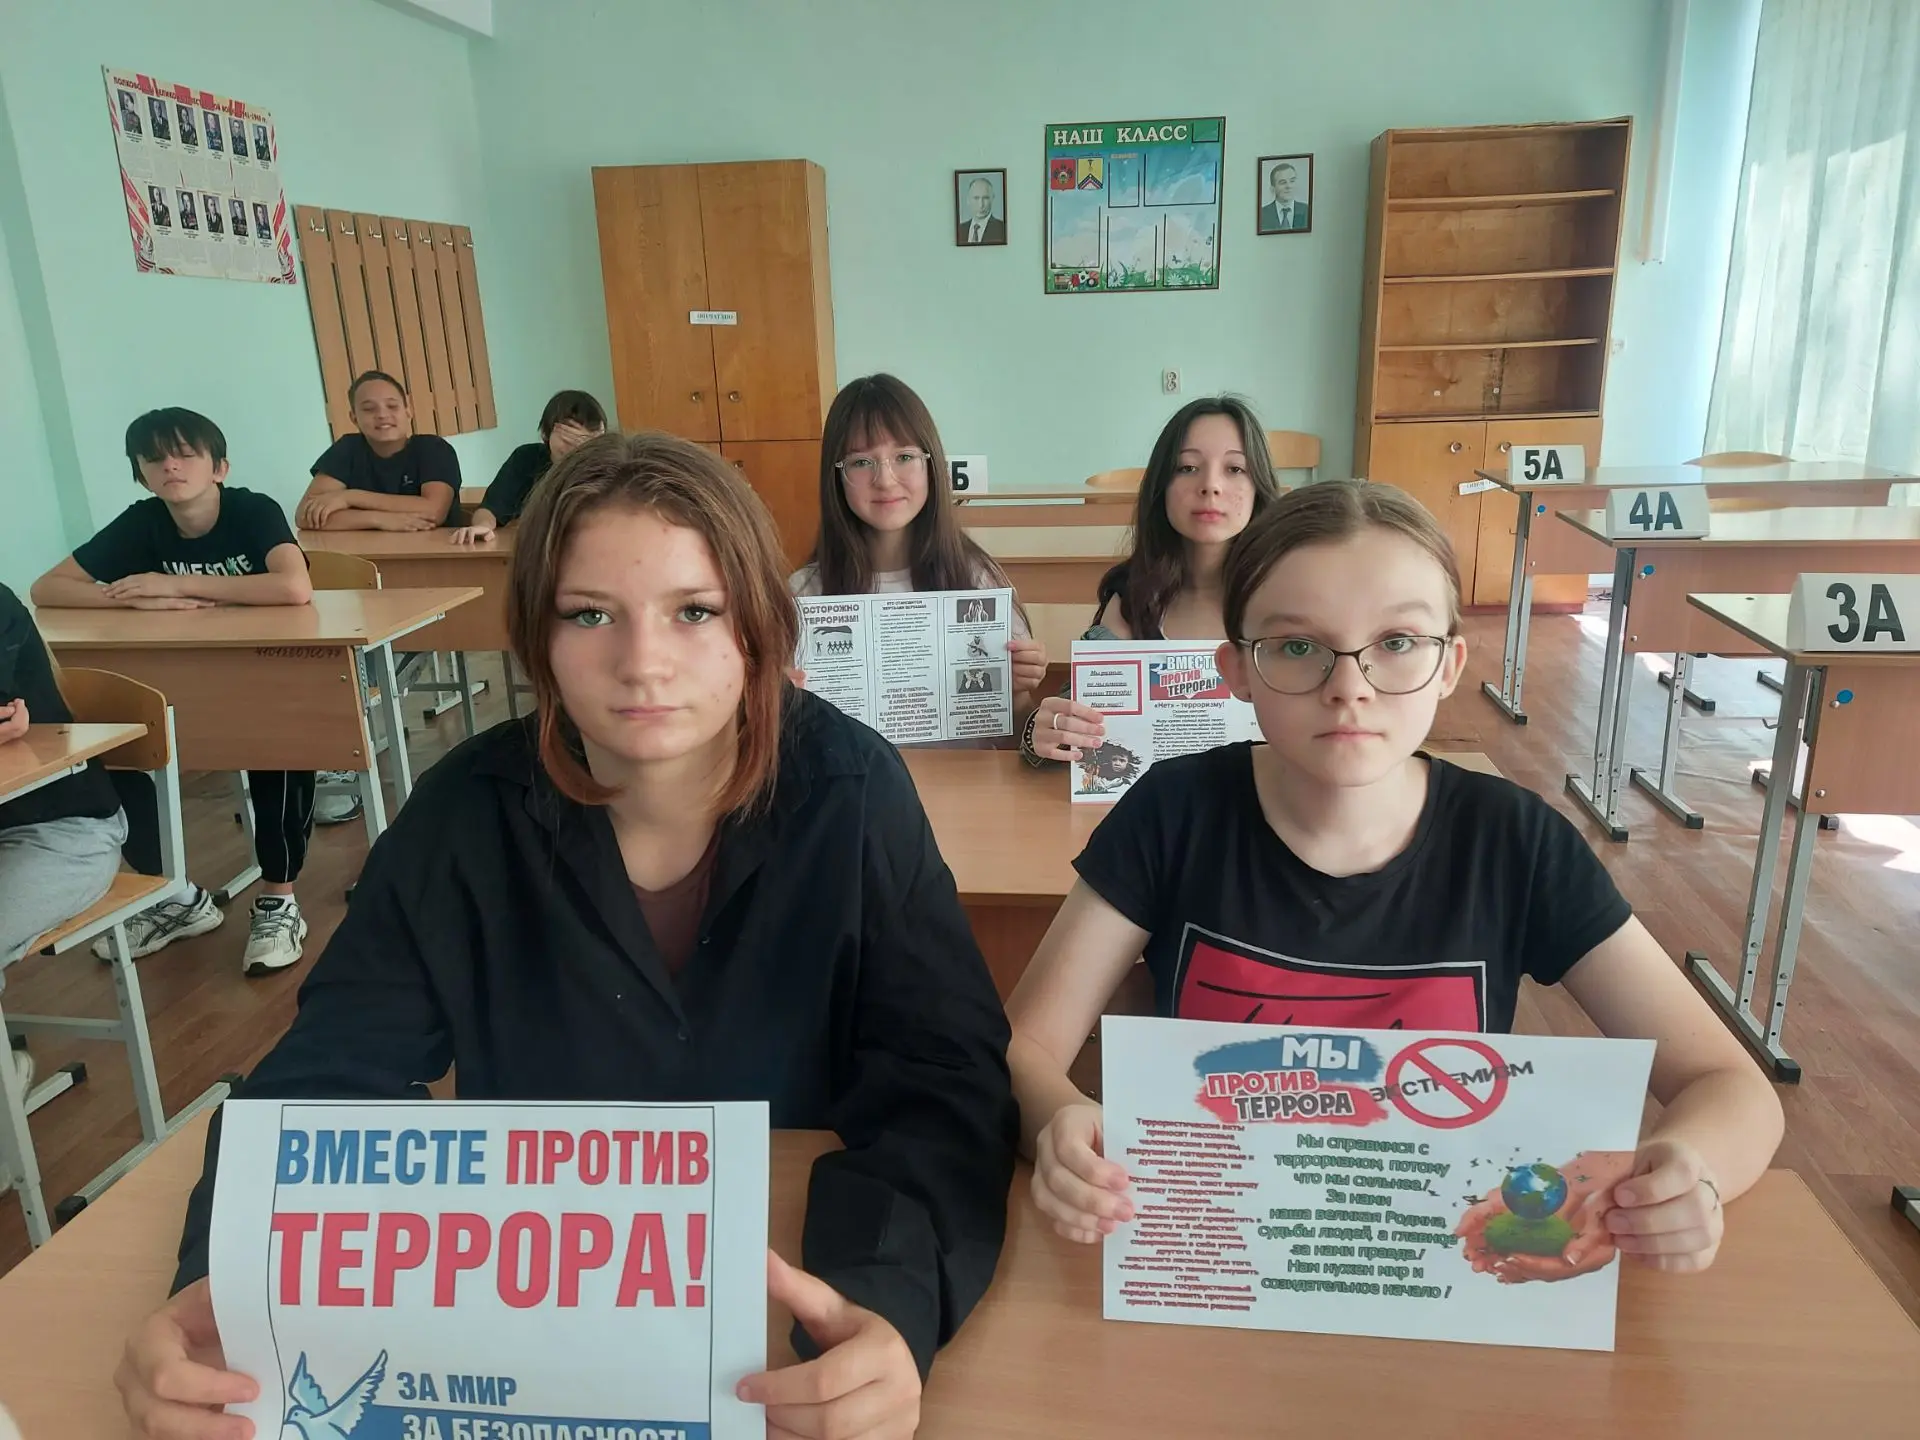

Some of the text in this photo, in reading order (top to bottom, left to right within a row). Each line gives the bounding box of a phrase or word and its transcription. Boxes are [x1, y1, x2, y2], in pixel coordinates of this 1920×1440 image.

[1053, 126, 1188, 145] НАШ КЛАСС
[1523, 449, 1563, 480] 5А
[947, 461, 969, 490] Б
[1628, 491, 1682, 531] 4А
[803, 604, 860, 614] ОСТОРОЖНО
[1826, 582, 1905, 642] 3А
[805, 615, 860, 625] ТЕРРОРИЗМ!
[1161, 669, 1200, 686] ПРОТИВ
[1168, 678, 1216, 696] ТЕРРОРА!
[1181, 701, 1225, 710] терроризму!
[1281, 1036, 1362, 1070] МЫ
[1208, 1071, 1318, 1096] ПРОТИВ
[1369, 1061, 1534, 1103] ЭКСТЕМИЗМ
[1234, 1093, 1354, 1120] ТЕРРОРА
[1297, 1134, 1429, 1155] Мы справимся с
[275, 1129, 709, 1185] ВМЕСТЕ ПРОТИВ
[1294, 1172, 1321, 1184] что
[1326, 1174, 1349, 1185] мы
[1389, 1160, 1450, 1177] потому
[1326, 1189, 1391, 1206] За нами
[1269, 1208, 1311, 1220] наша
[1315, 1209, 1381, 1222] великая
[1258, 1224, 1315, 1240] судьбы
[1377, 1230, 1388, 1241] а
[1391, 1230, 1458, 1245] главное
[271, 1210, 706, 1308] ТЕРРОРА!
[1292, 1244, 1310, 1255] за
[1314, 1245, 1354, 1257] нами
[1287, 1260, 1423, 1280] Нам нужен мир и
[1261, 1277, 1379, 1294] созидательное
[397, 1372, 517, 1406] ЗА МИР
[403, 1414, 443, 1440] ЗА
